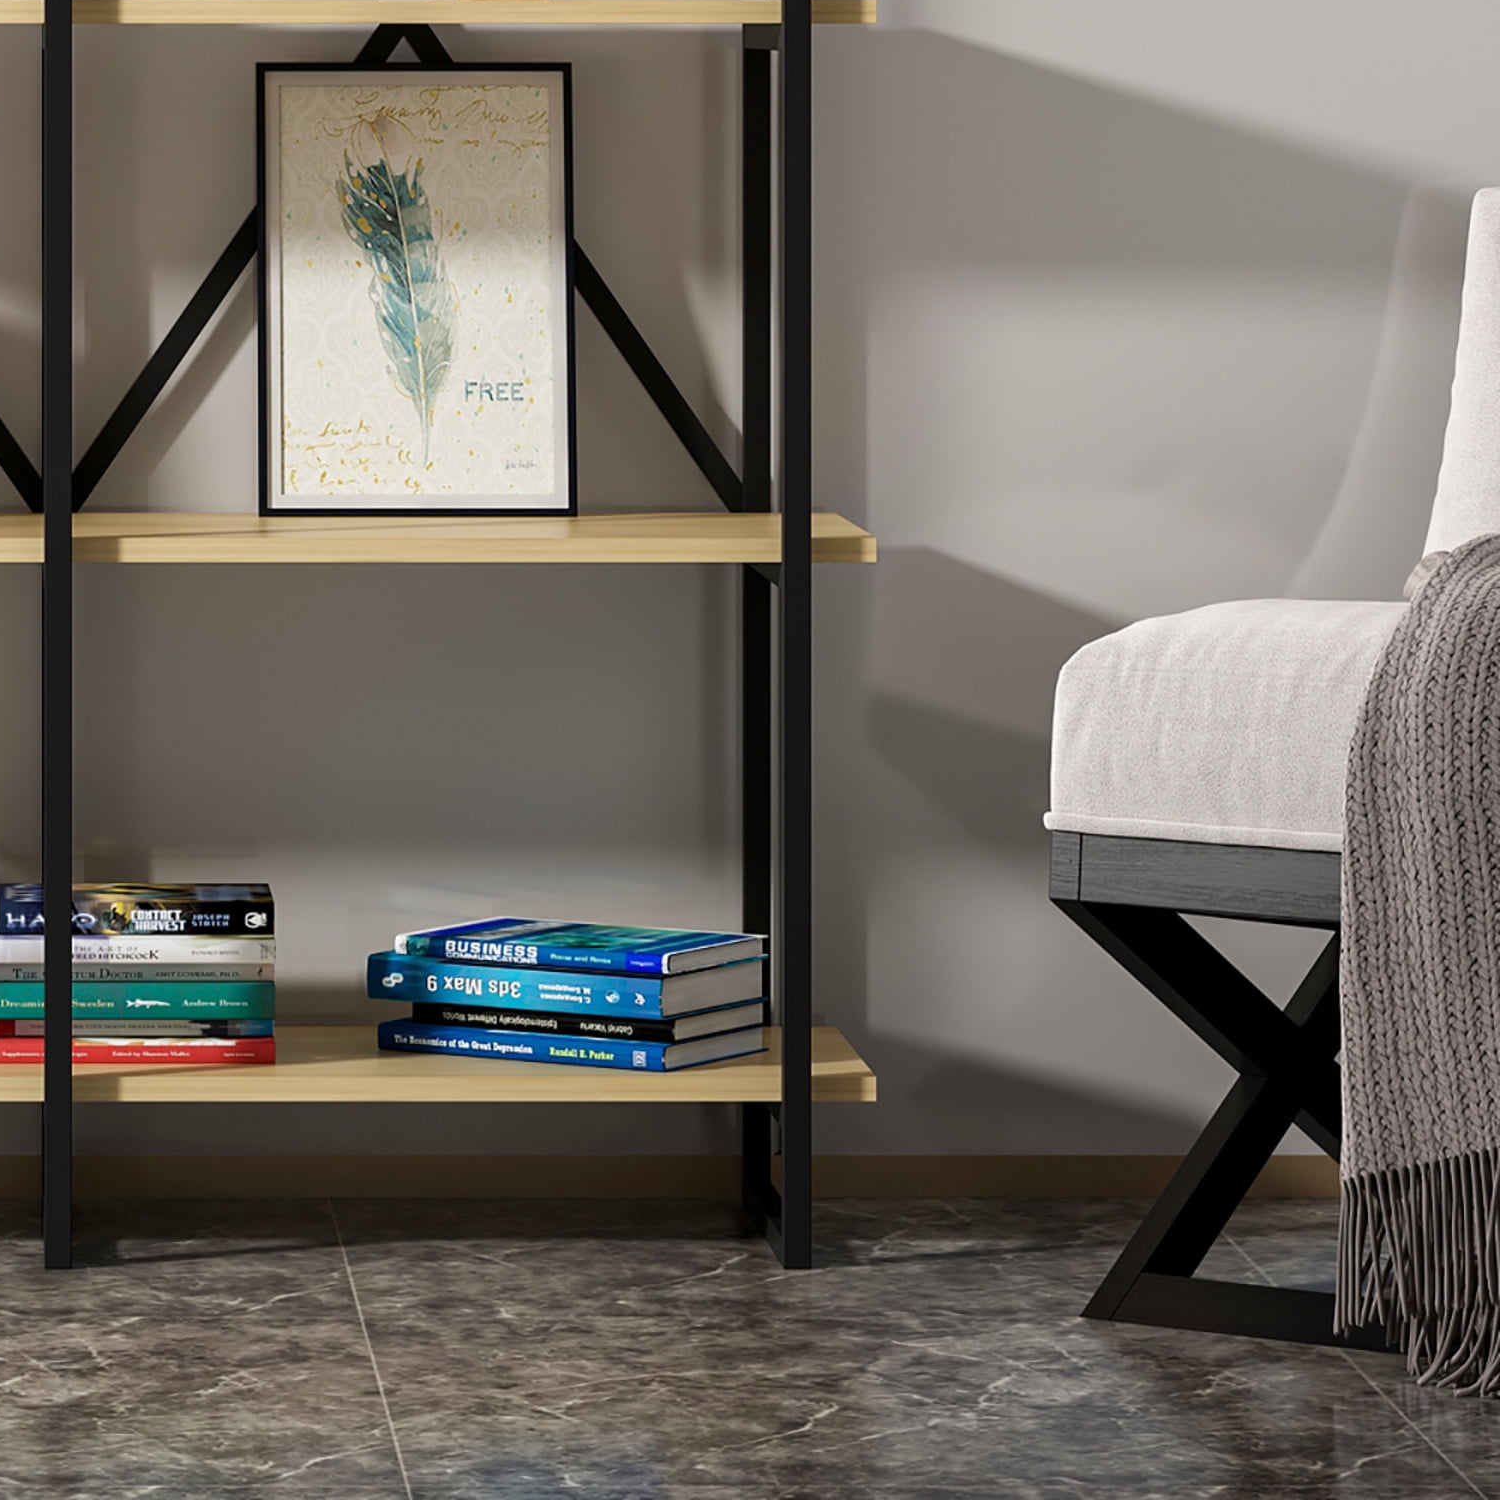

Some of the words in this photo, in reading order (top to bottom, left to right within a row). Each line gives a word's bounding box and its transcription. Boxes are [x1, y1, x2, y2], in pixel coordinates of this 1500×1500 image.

[464, 379, 524, 402] FREE
[5, 912, 98, 929] HAO
[130, 909, 183, 921] CONTACT
[134, 920, 187, 931] HARVEST
[445, 940, 538, 958] BUSINESS
[445, 951, 538, 965] COMMUNICATIONS
[12, 968, 37, 979] THE
[100, 968, 143, 979] DOCTOR
[426, 974, 438, 992] 9
[443, 975, 482, 996] Max
[488, 980, 521, 998] 3ds
[72, 999, 115, 1008] Sweden
[182, 999, 216, 1007] Andrew
[219, 999, 248, 1007] Brown
[394, 1034, 408, 1044] The
[449, 1039, 457, 1048] of
[458, 1039, 470, 1049] the
[589, 1049, 614, 1060] Parker
